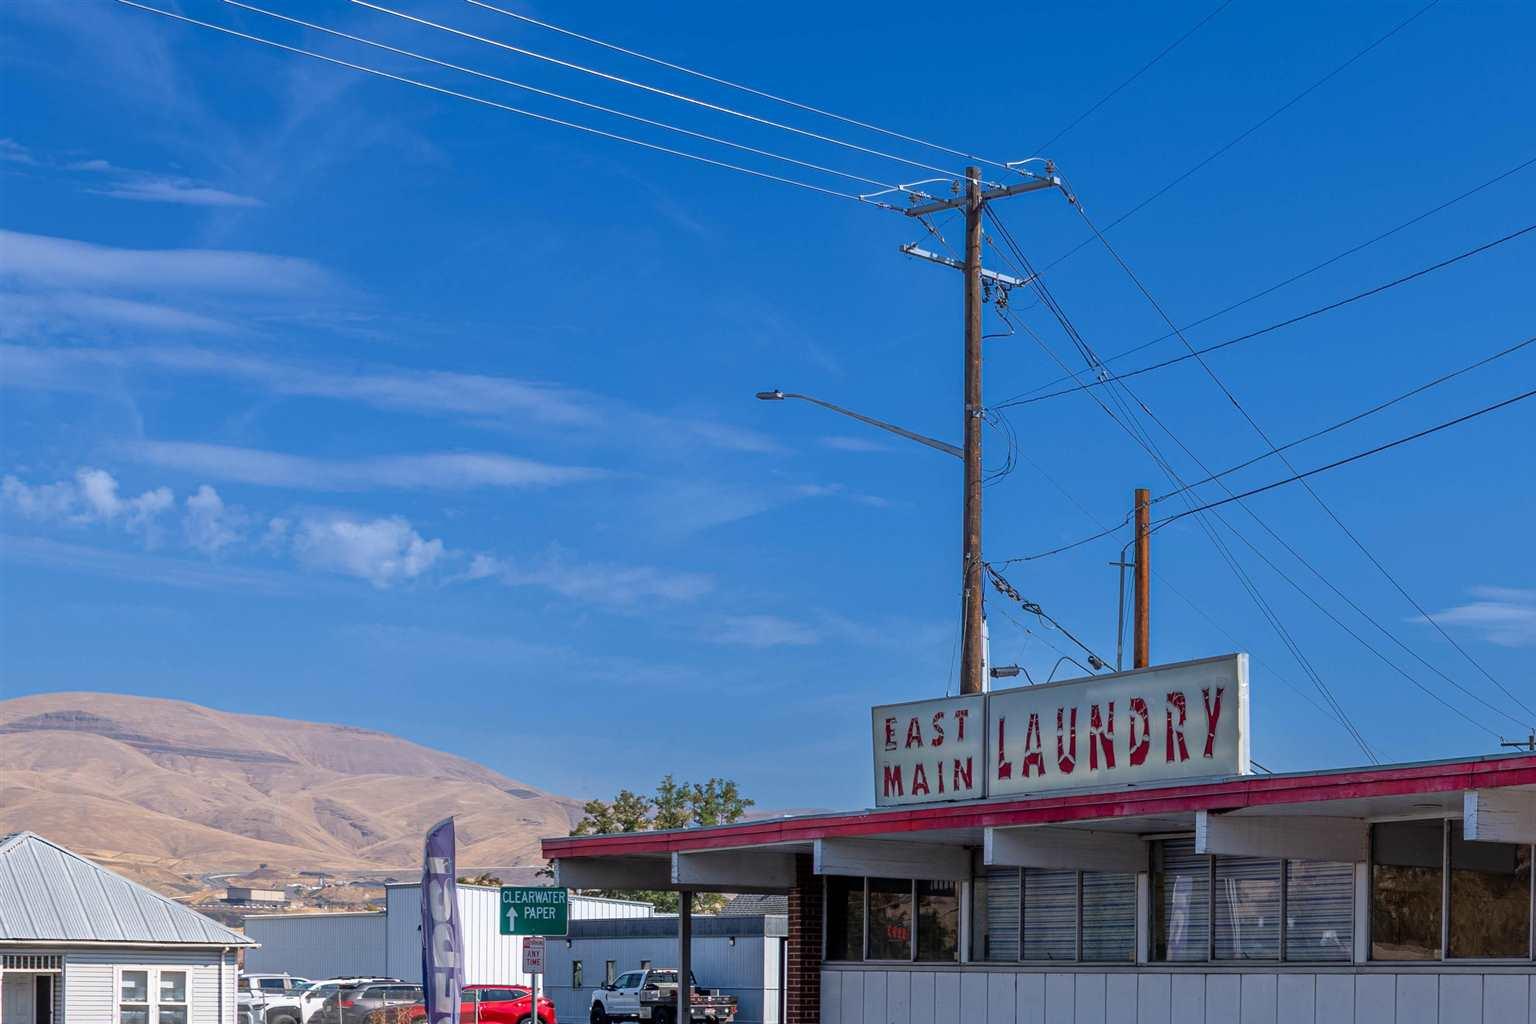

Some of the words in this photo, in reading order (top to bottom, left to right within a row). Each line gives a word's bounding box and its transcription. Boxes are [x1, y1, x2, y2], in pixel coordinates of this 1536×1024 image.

[884, 709, 969, 752] EAST
[998, 687, 1225, 780] LAUNDRY
[883, 757, 973, 798] MAIN
[502, 890, 566, 904] CLEARWATER
[524, 906, 556, 919] PAPER
